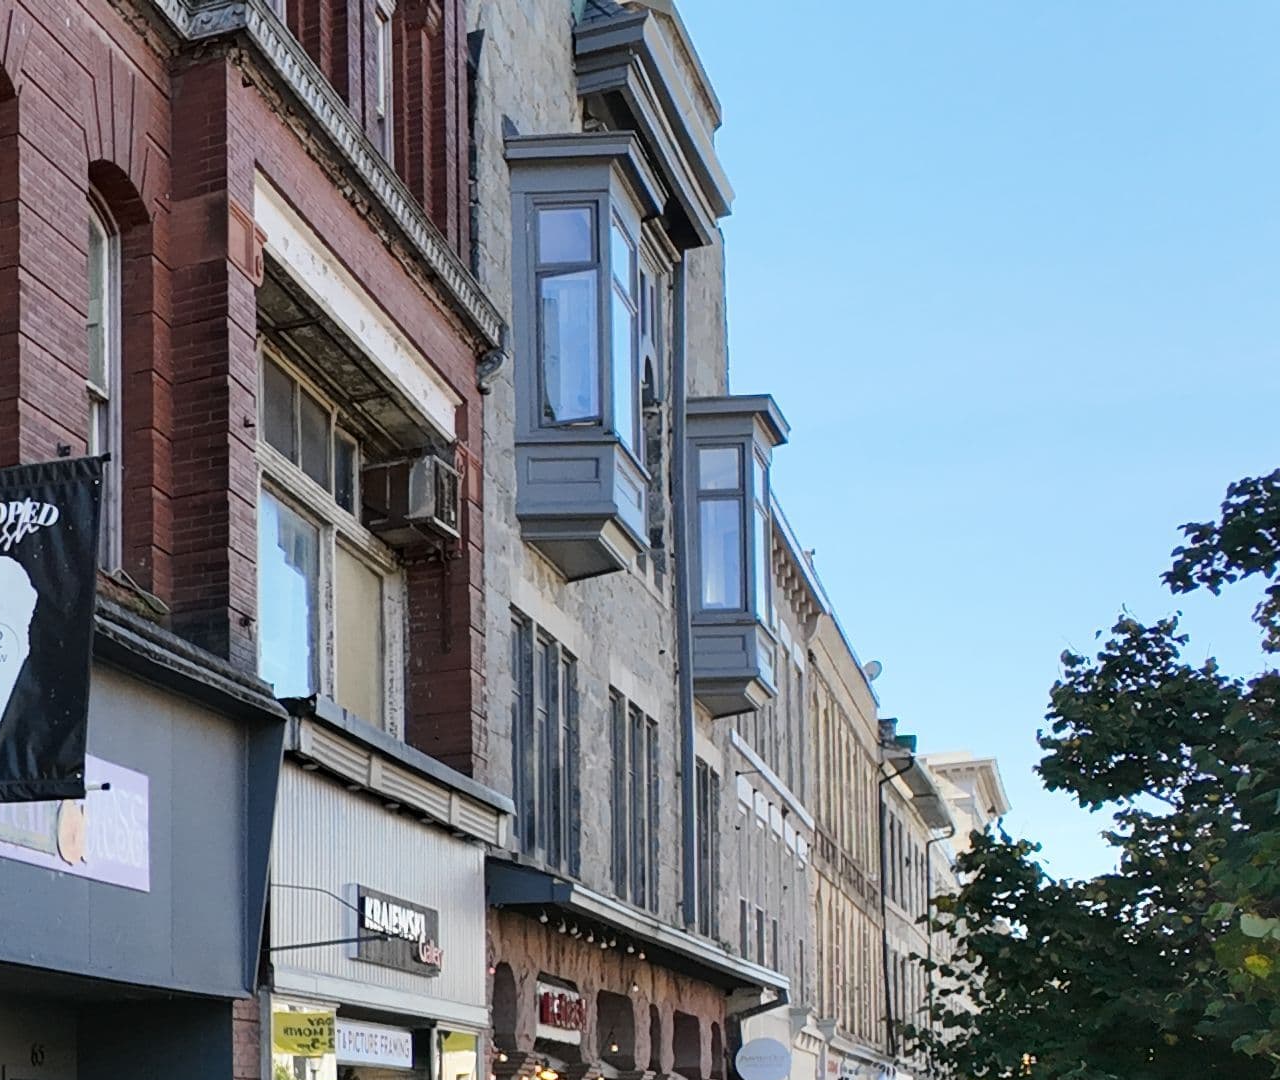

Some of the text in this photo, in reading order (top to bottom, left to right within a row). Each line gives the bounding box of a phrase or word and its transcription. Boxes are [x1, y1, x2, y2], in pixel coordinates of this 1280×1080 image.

[364, 896, 426, 942] KRAJEWSKI
[348, 1030, 379, 1056] PICTURE
[380, 1034, 410, 1059] FRAMING
